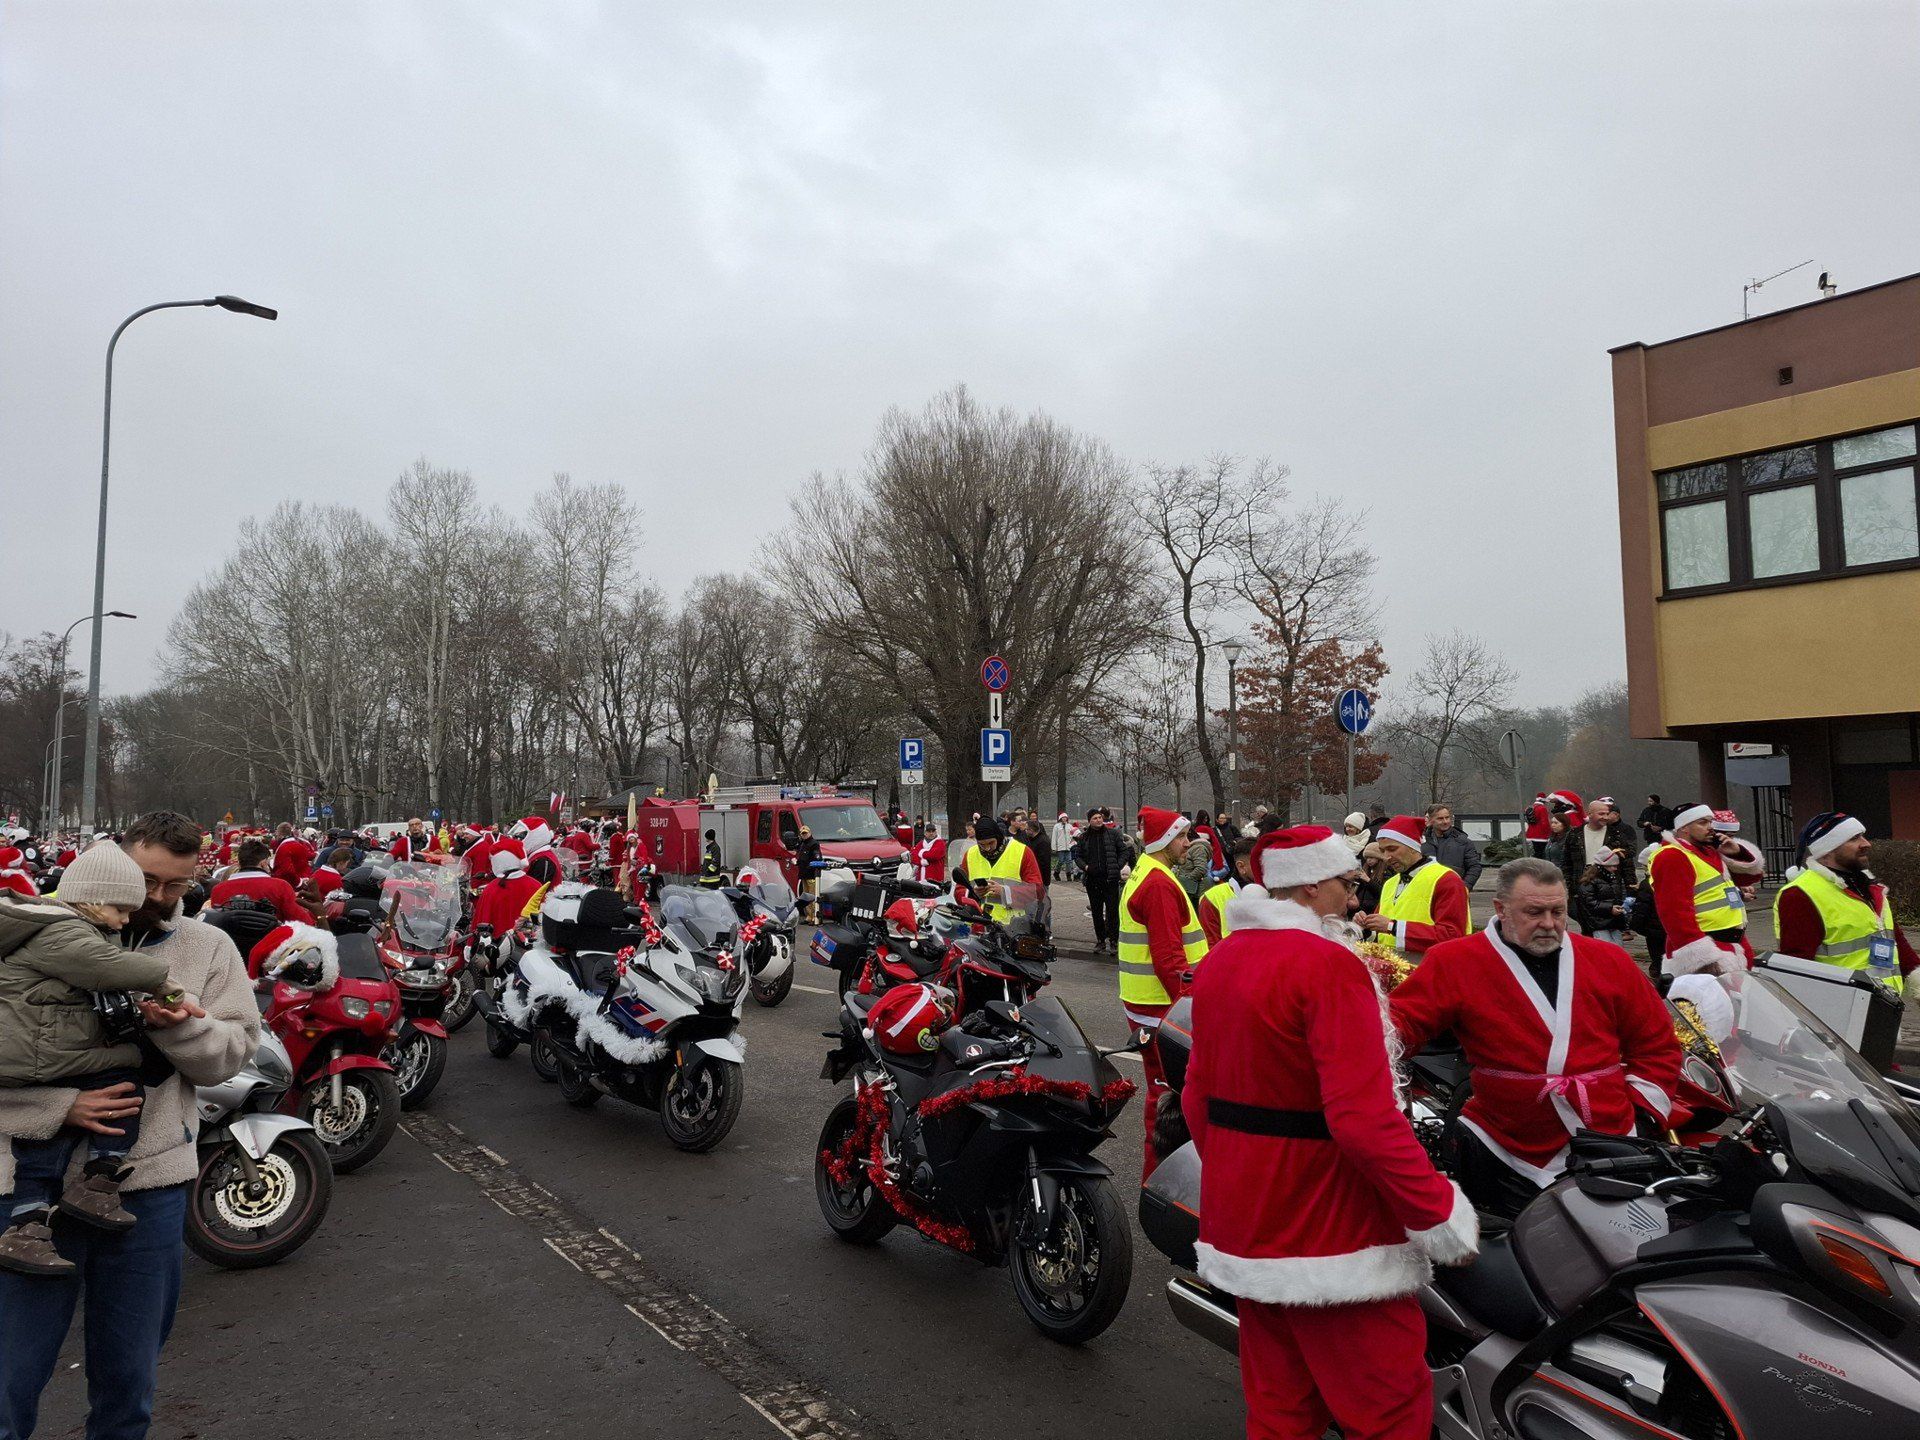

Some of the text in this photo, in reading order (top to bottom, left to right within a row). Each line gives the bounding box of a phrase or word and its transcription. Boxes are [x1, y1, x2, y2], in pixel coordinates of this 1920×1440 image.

[905, 741, 918, 761] P
[988, 733, 1005, 761] P
[307, 808, 315, 817] P
[1797, 1351, 1847, 1378] HONDA
